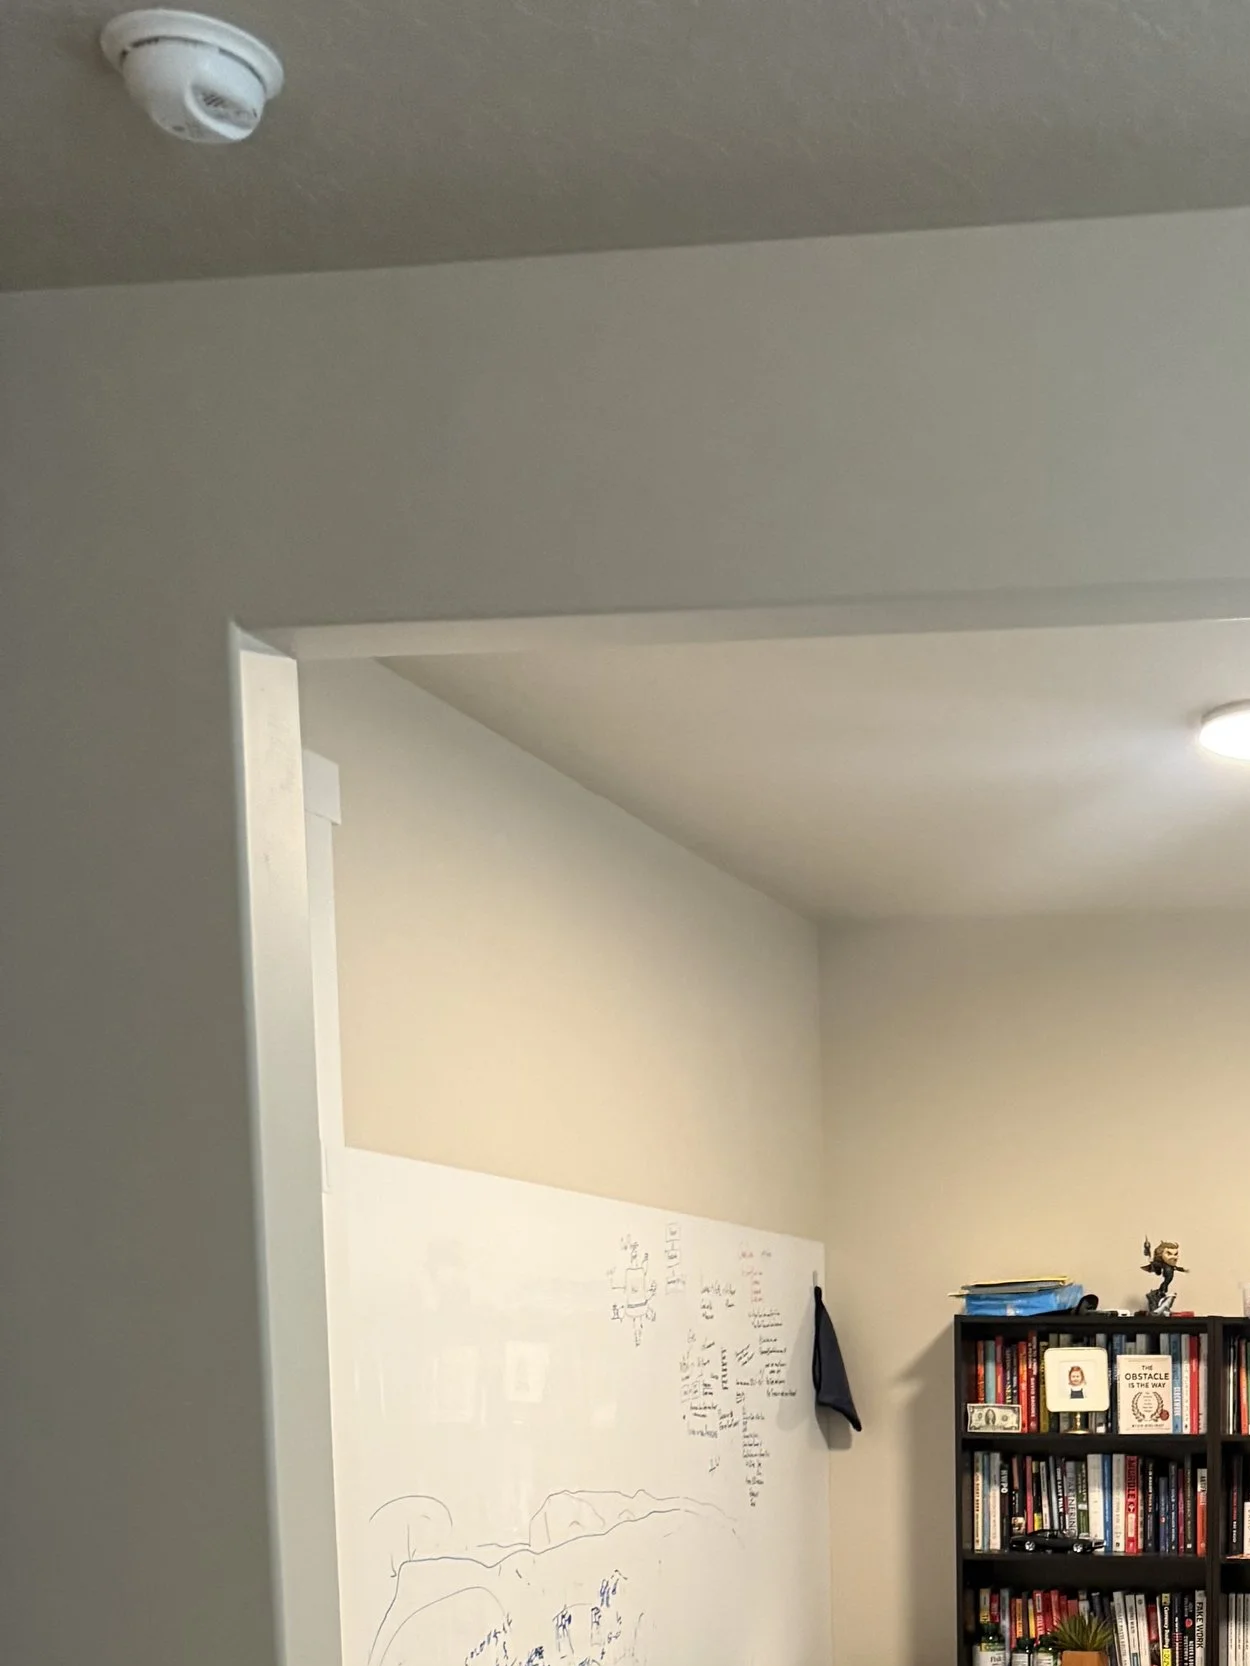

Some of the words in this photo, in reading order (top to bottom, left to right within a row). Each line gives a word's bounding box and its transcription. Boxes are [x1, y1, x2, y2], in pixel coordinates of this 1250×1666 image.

[1124, 1372, 1170, 1381] OBSTACLE
[1173, 1386, 1181, 1416] CLOCKWORK
[1196, 1602, 1204, 1623] FAKE
[1196, 1625, 1204, 1648] WORK
